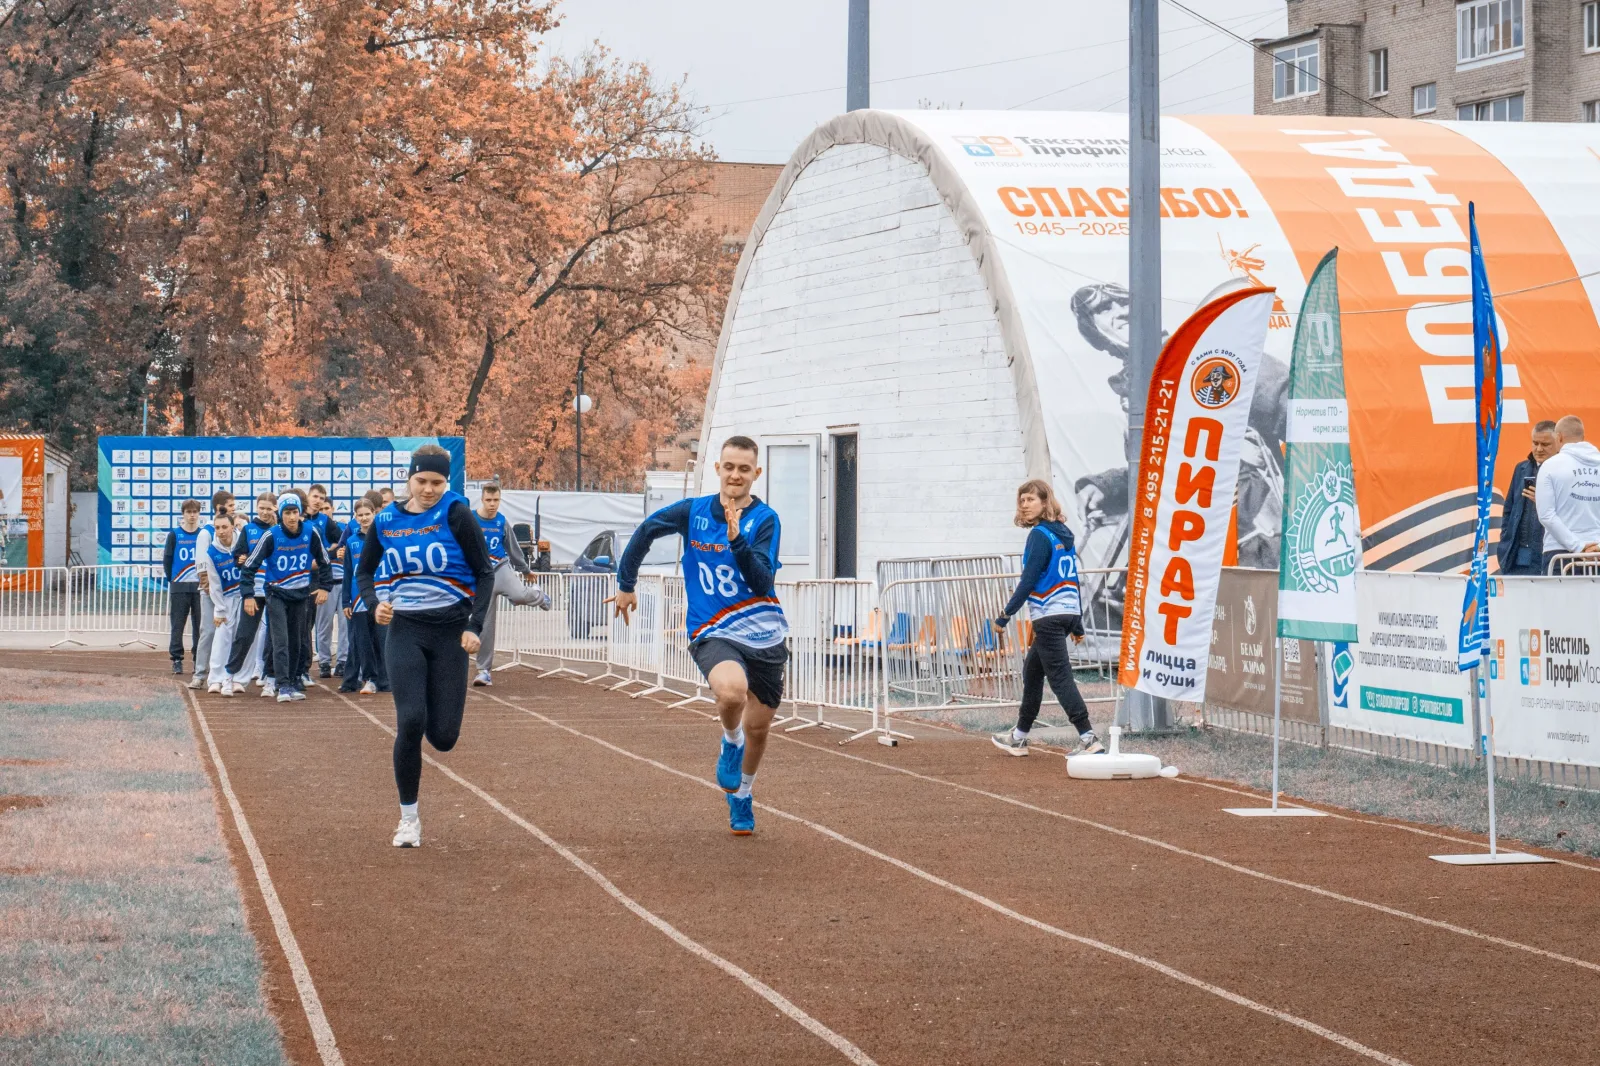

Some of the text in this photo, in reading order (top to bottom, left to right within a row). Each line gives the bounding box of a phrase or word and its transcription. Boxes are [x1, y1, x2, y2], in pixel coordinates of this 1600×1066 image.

[1279, 128, 1530, 425] ПОБЕДА!
[1327, 406, 1338, 417] ГТО
[1331, 425, 1348, 433] жизн
[1572, 468, 1599, 477] РОССИ
[1125, 379, 1175, 672] www.pizzapirat.ru 8 495 215-21-21
[1158, 416, 1224, 646] ПИРАТ
[178, 547, 196, 562] 01
[276, 553, 308, 572] 028
[385, 541, 448, 575] 050
[1330, 552, 1354, 575] ГТО
[697, 561, 748, 598] 08
[1240, 641, 1264, 659] БЕЛЫЙ
[1543, 629, 1590, 656] Текстиль
[1145, 650, 1197, 672] пицца
[1241, 658, 1266, 676] ЖИРАФ
[1142, 667, 1196, 688] и суши
